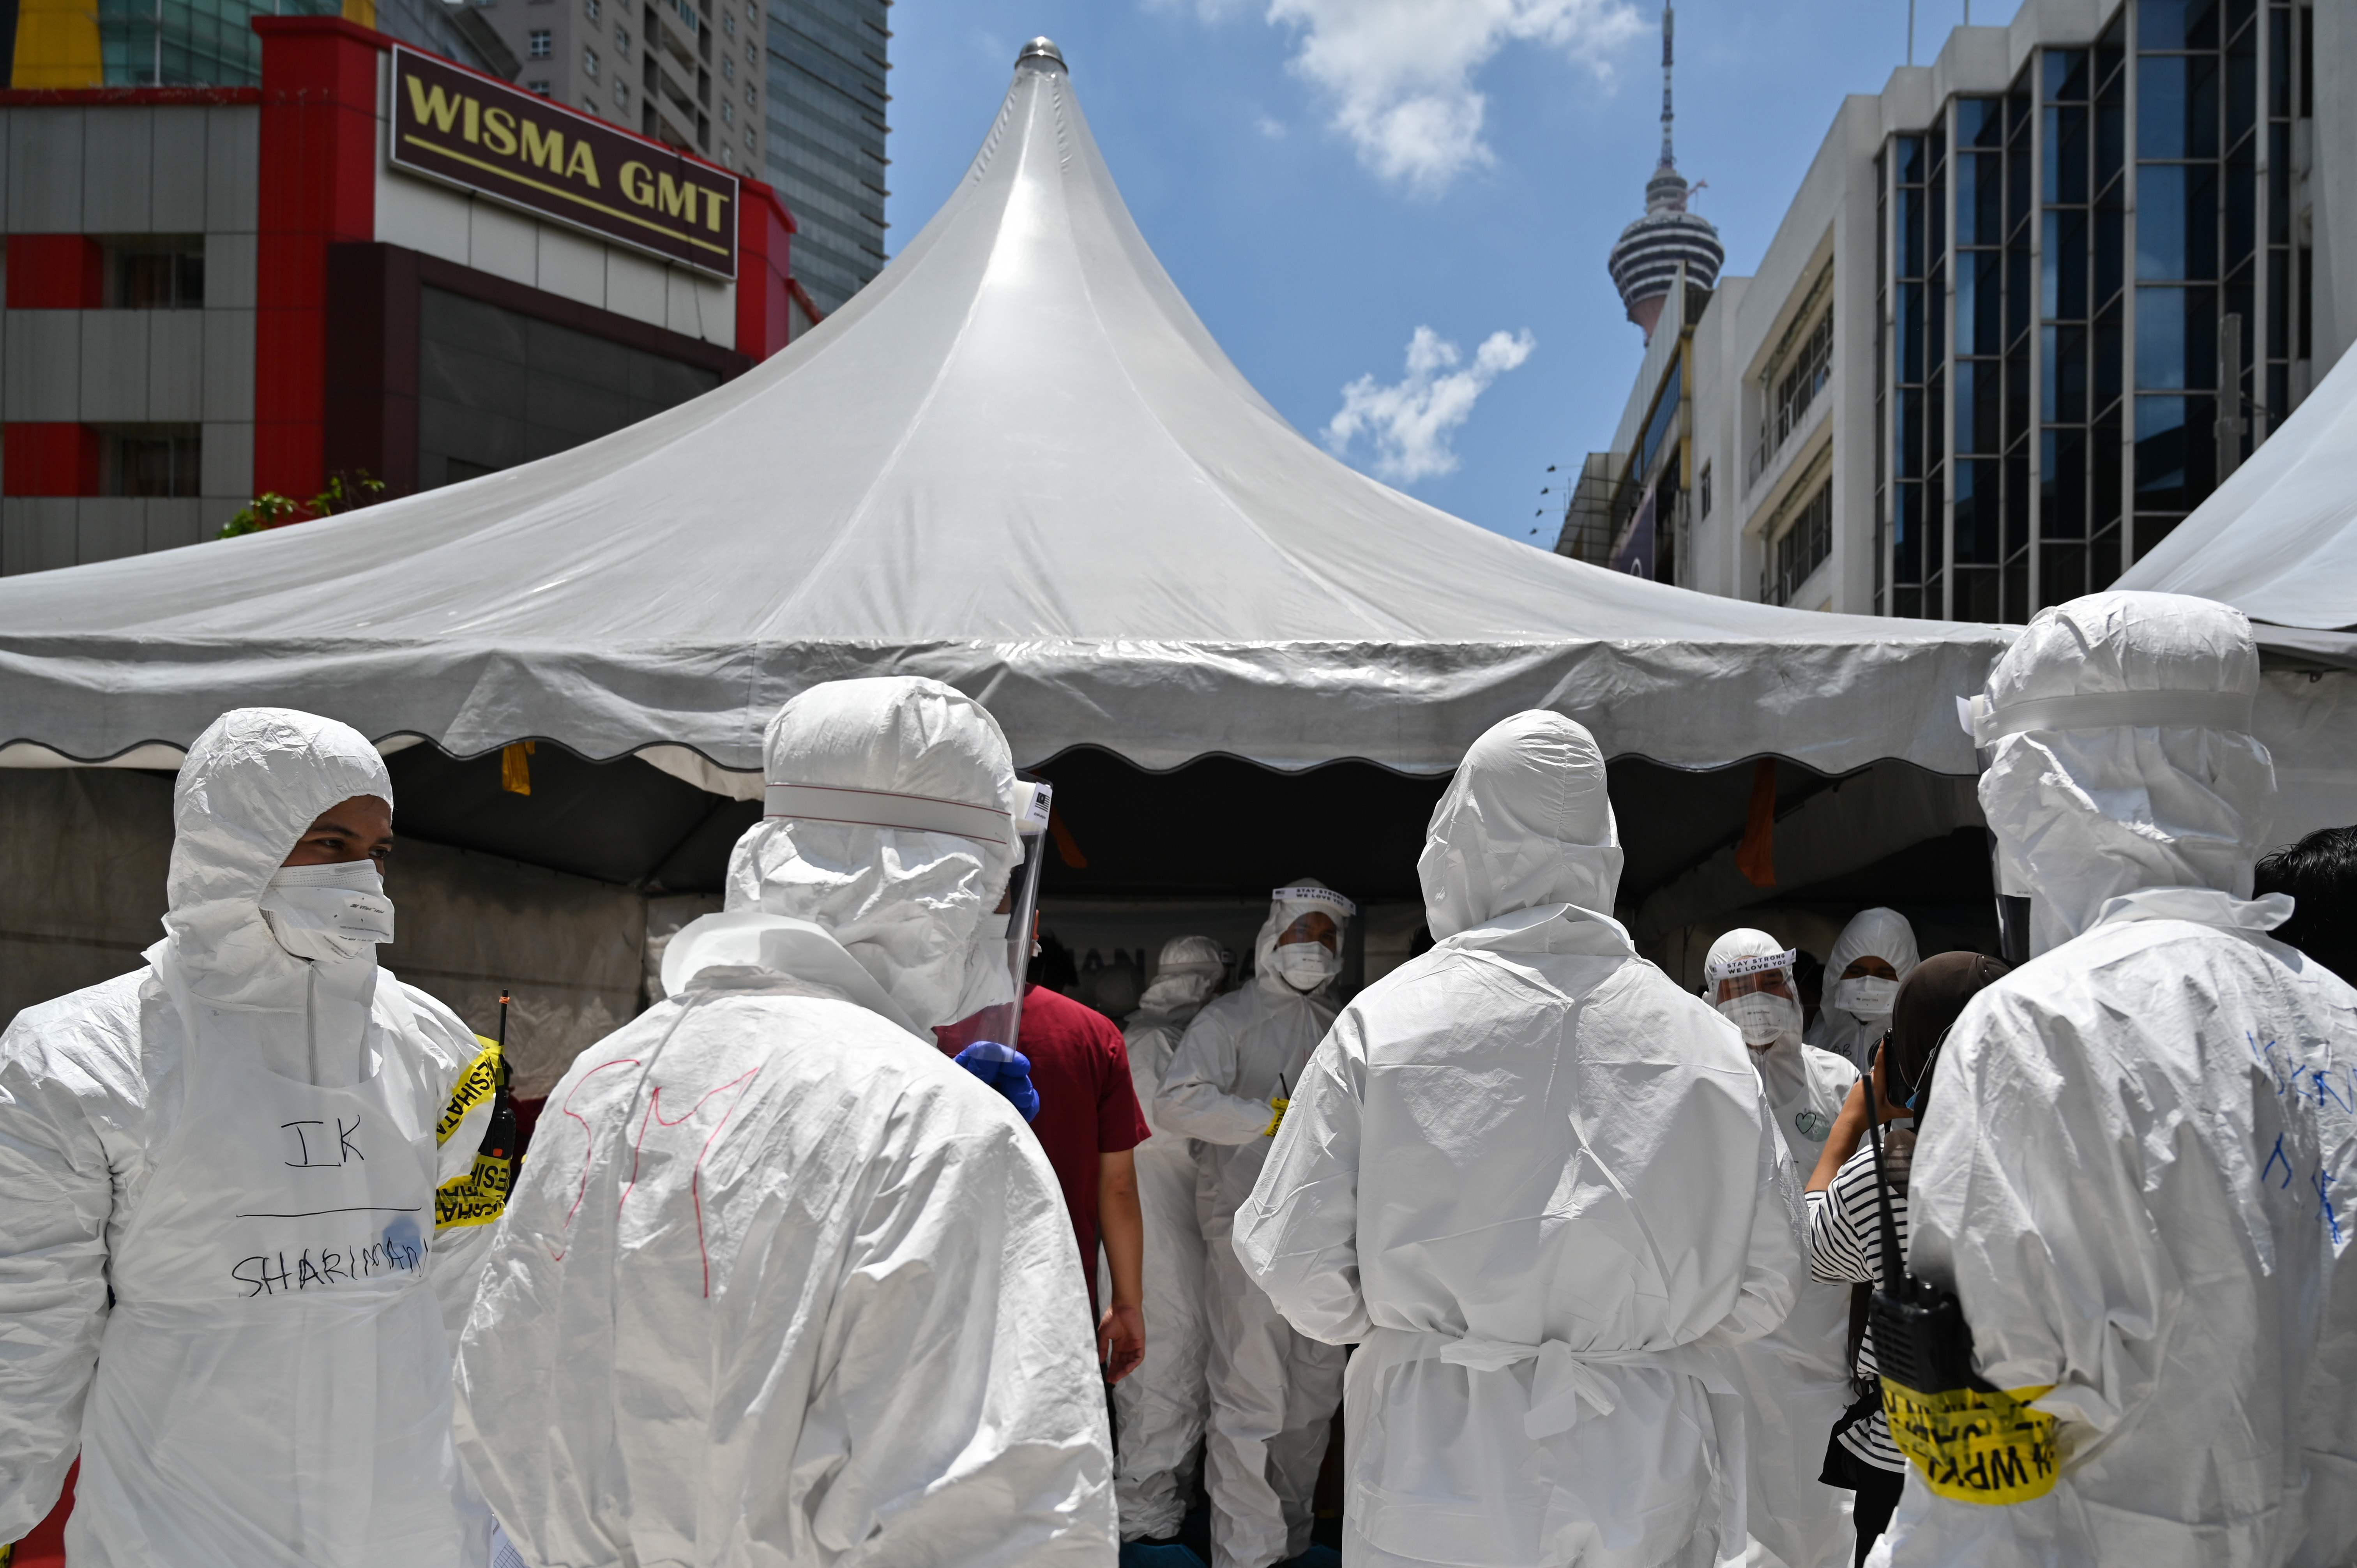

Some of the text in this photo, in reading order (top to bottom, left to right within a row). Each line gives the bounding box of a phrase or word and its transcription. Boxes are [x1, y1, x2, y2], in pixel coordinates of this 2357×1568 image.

[406, 74, 730, 233] WISMA GMT
[1727, 960, 1748, 968] STAY
[1752, 953, 1785, 964] STRONG
[1745, 963, 1768, 972] LOVE
